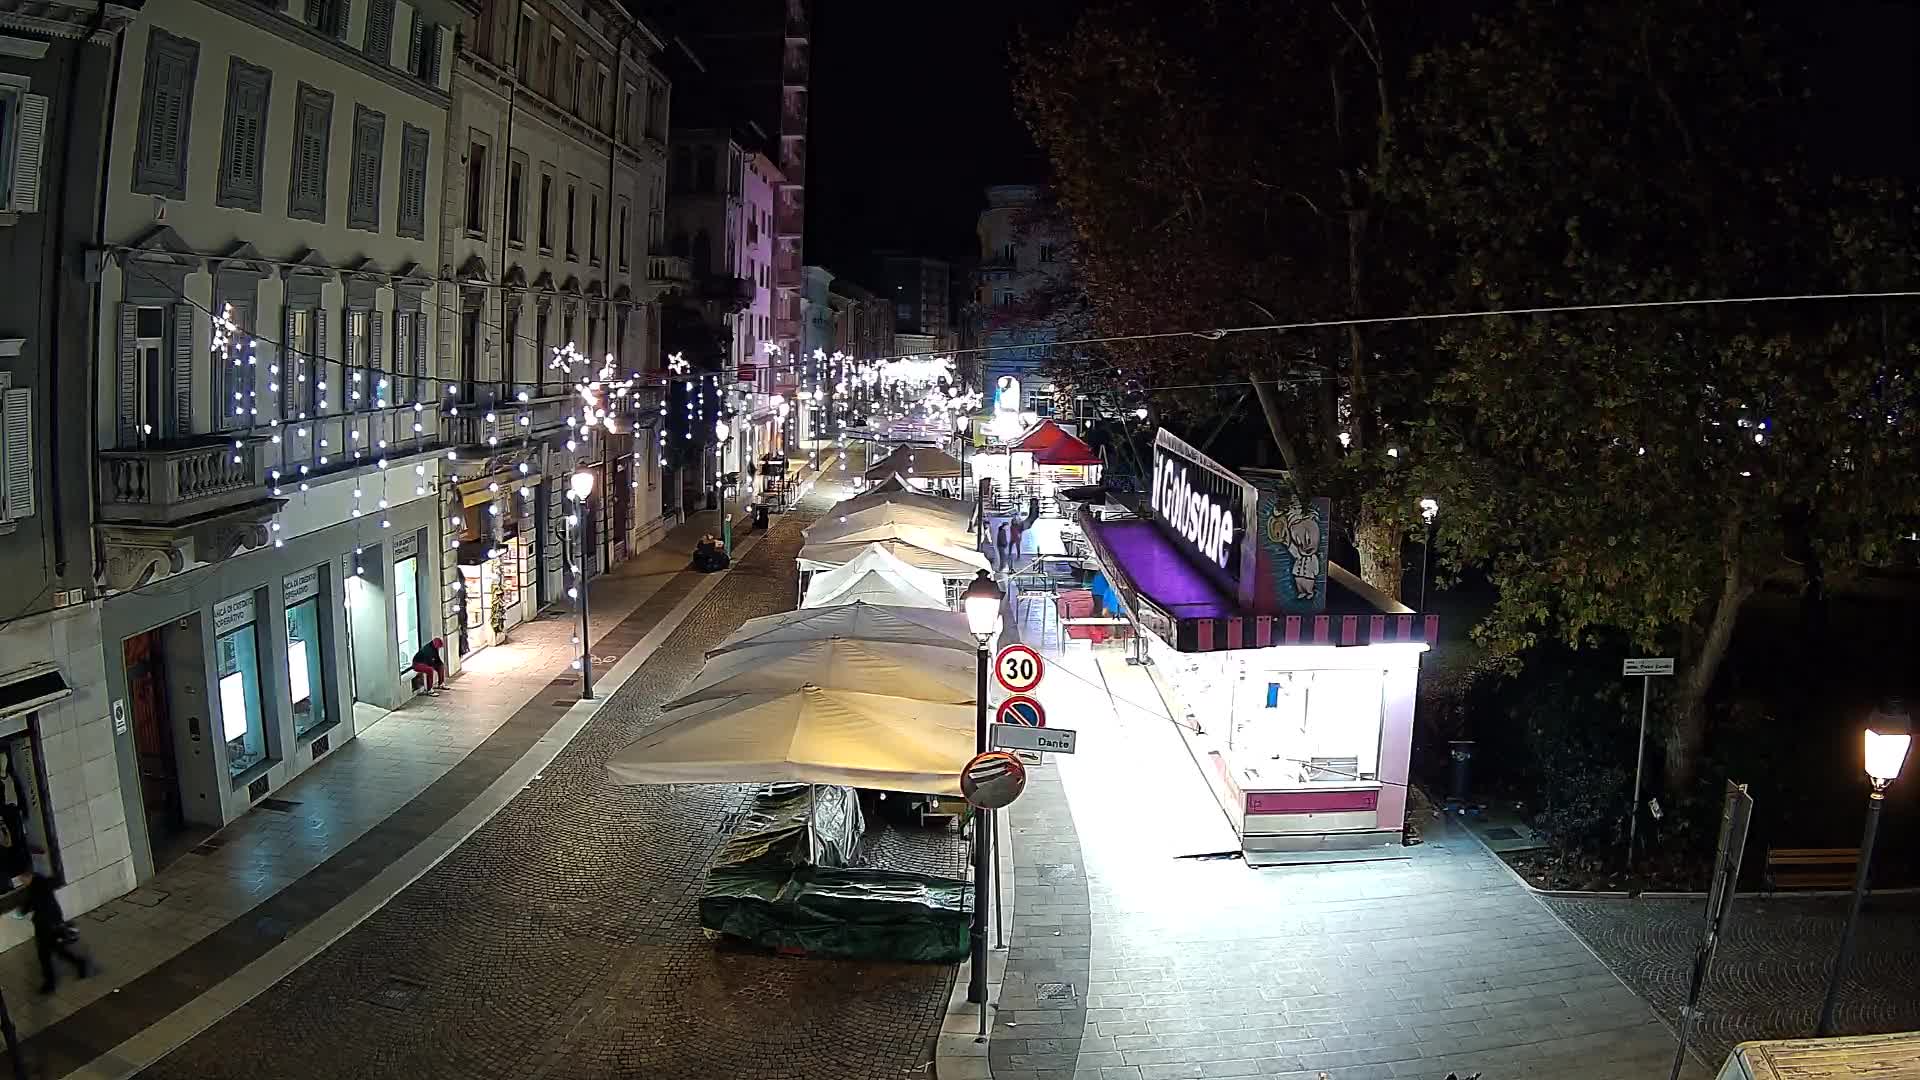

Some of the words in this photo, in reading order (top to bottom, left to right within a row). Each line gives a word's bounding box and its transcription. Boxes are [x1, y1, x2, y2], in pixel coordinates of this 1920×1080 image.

[1162, 459, 1233, 568] Golosone
[1006, 658, 1033, 680] 30
[1038, 737, 1069, 749] Dante
